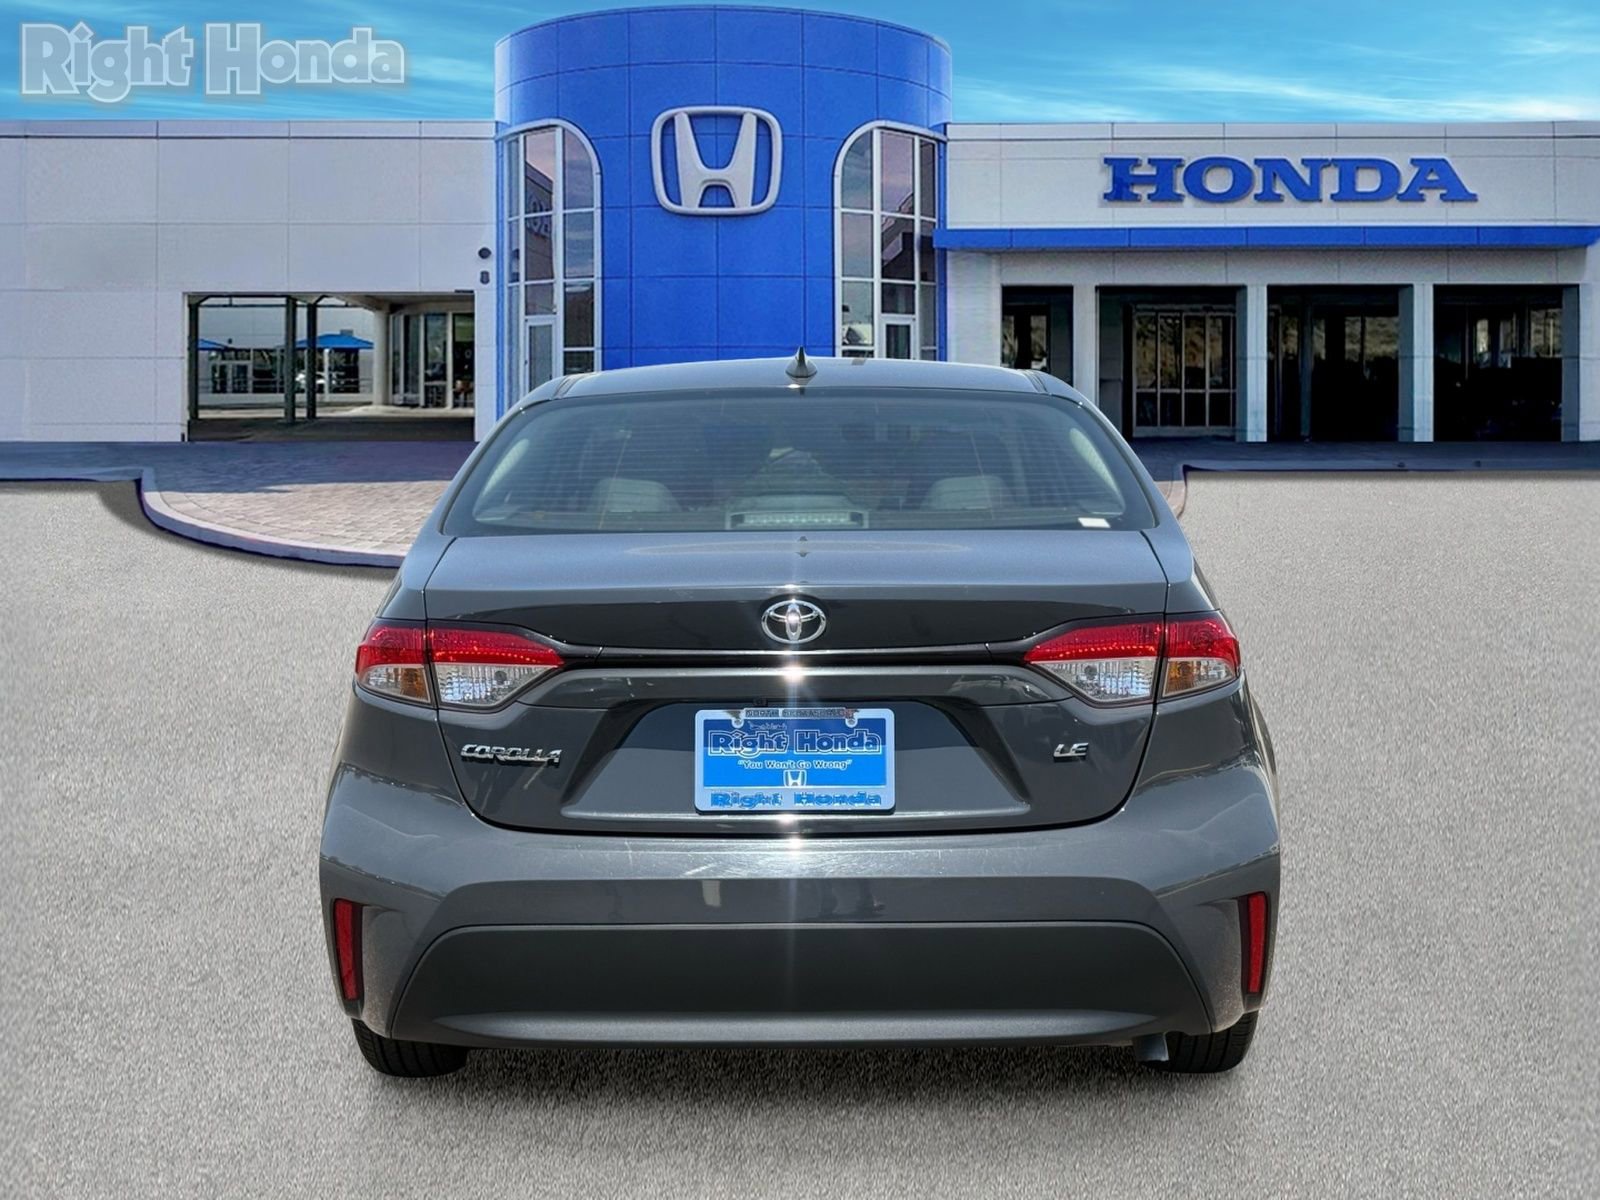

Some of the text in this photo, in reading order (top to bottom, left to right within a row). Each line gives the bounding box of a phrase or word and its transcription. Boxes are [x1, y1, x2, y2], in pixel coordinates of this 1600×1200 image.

[1103, 156, 1478, 202] HONDA
[709, 728, 882, 758] Right Honda
[1053, 742, 1089, 757] LE
[461, 744, 562, 764] COROLLA
[797, 760, 812, 769] Go
[711, 791, 882, 809] Right Honda
